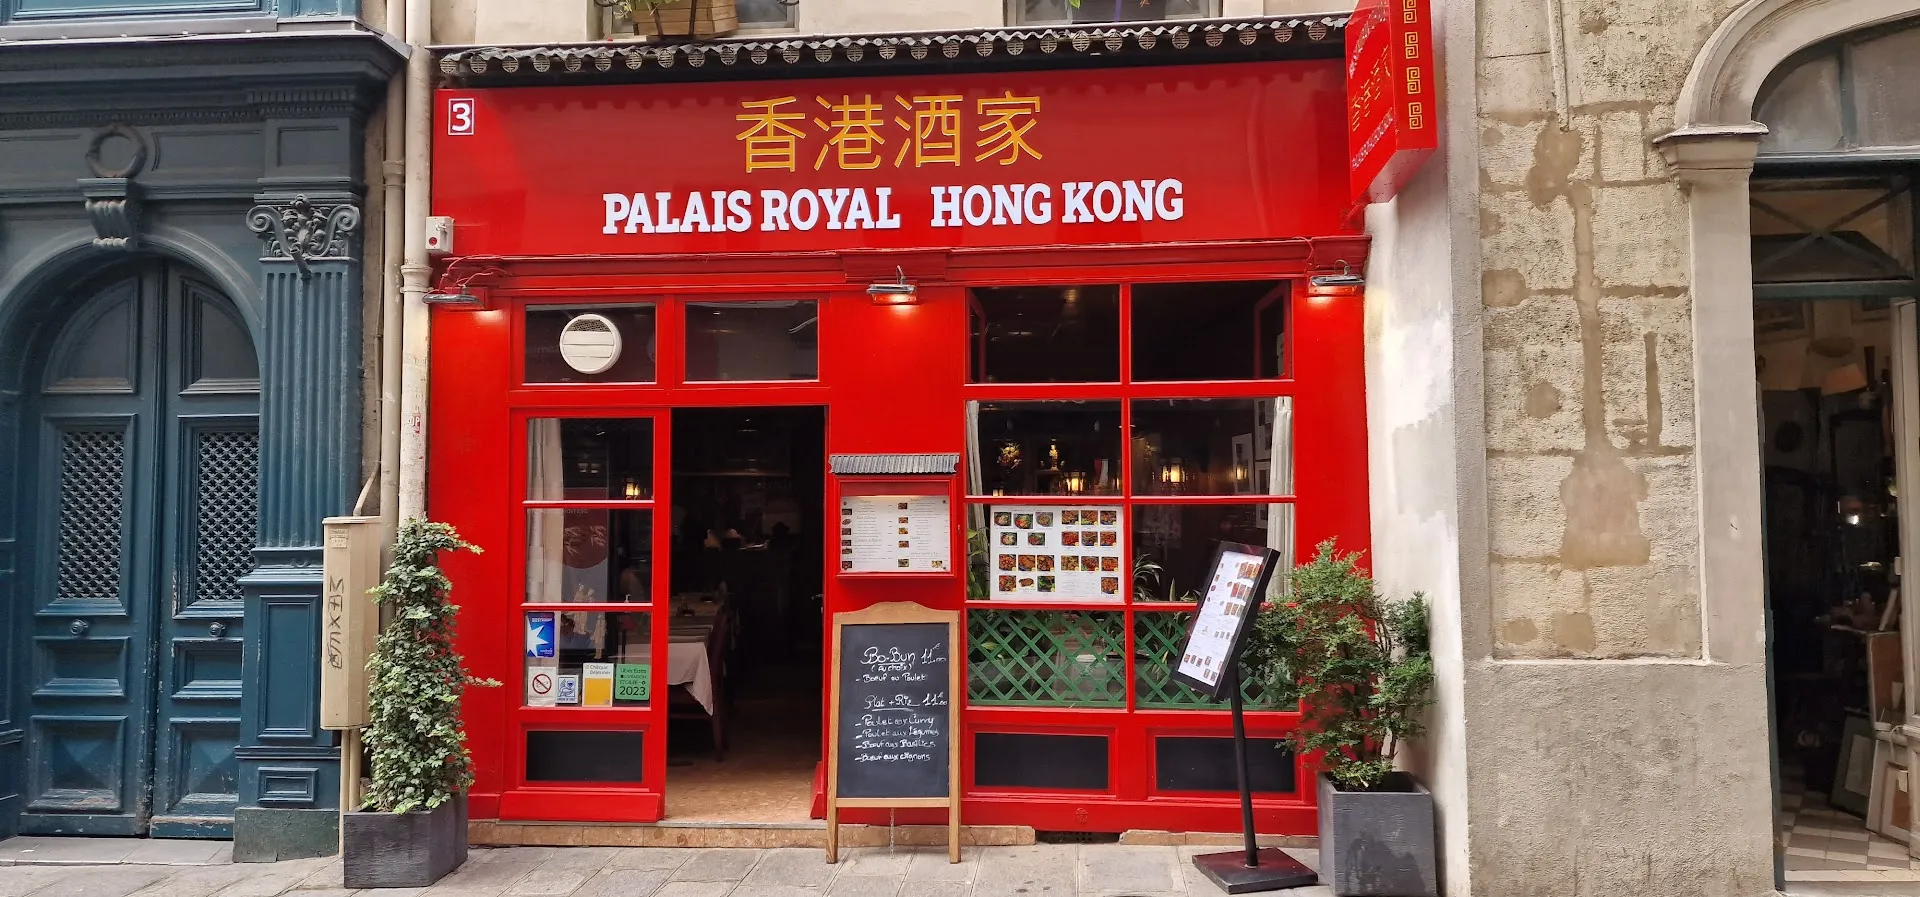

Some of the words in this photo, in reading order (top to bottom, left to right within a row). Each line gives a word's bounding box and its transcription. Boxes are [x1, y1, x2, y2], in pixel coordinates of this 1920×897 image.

[452, 103, 471, 131] 3
[736, 91, 1043, 173] 香港酒家
[602, 190, 752, 235] PALAIS
[760, 187, 901, 232] ROYAL
[930, 183, 1052, 228] HONG
[1061, 178, 1185, 224] KONG
[860, 646, 916, 665] Bo-Bun
[902, 672, 926, 681] Poulet
[620, 686, 646, 696] 2023
[864, 695, 885, 710] Plat
